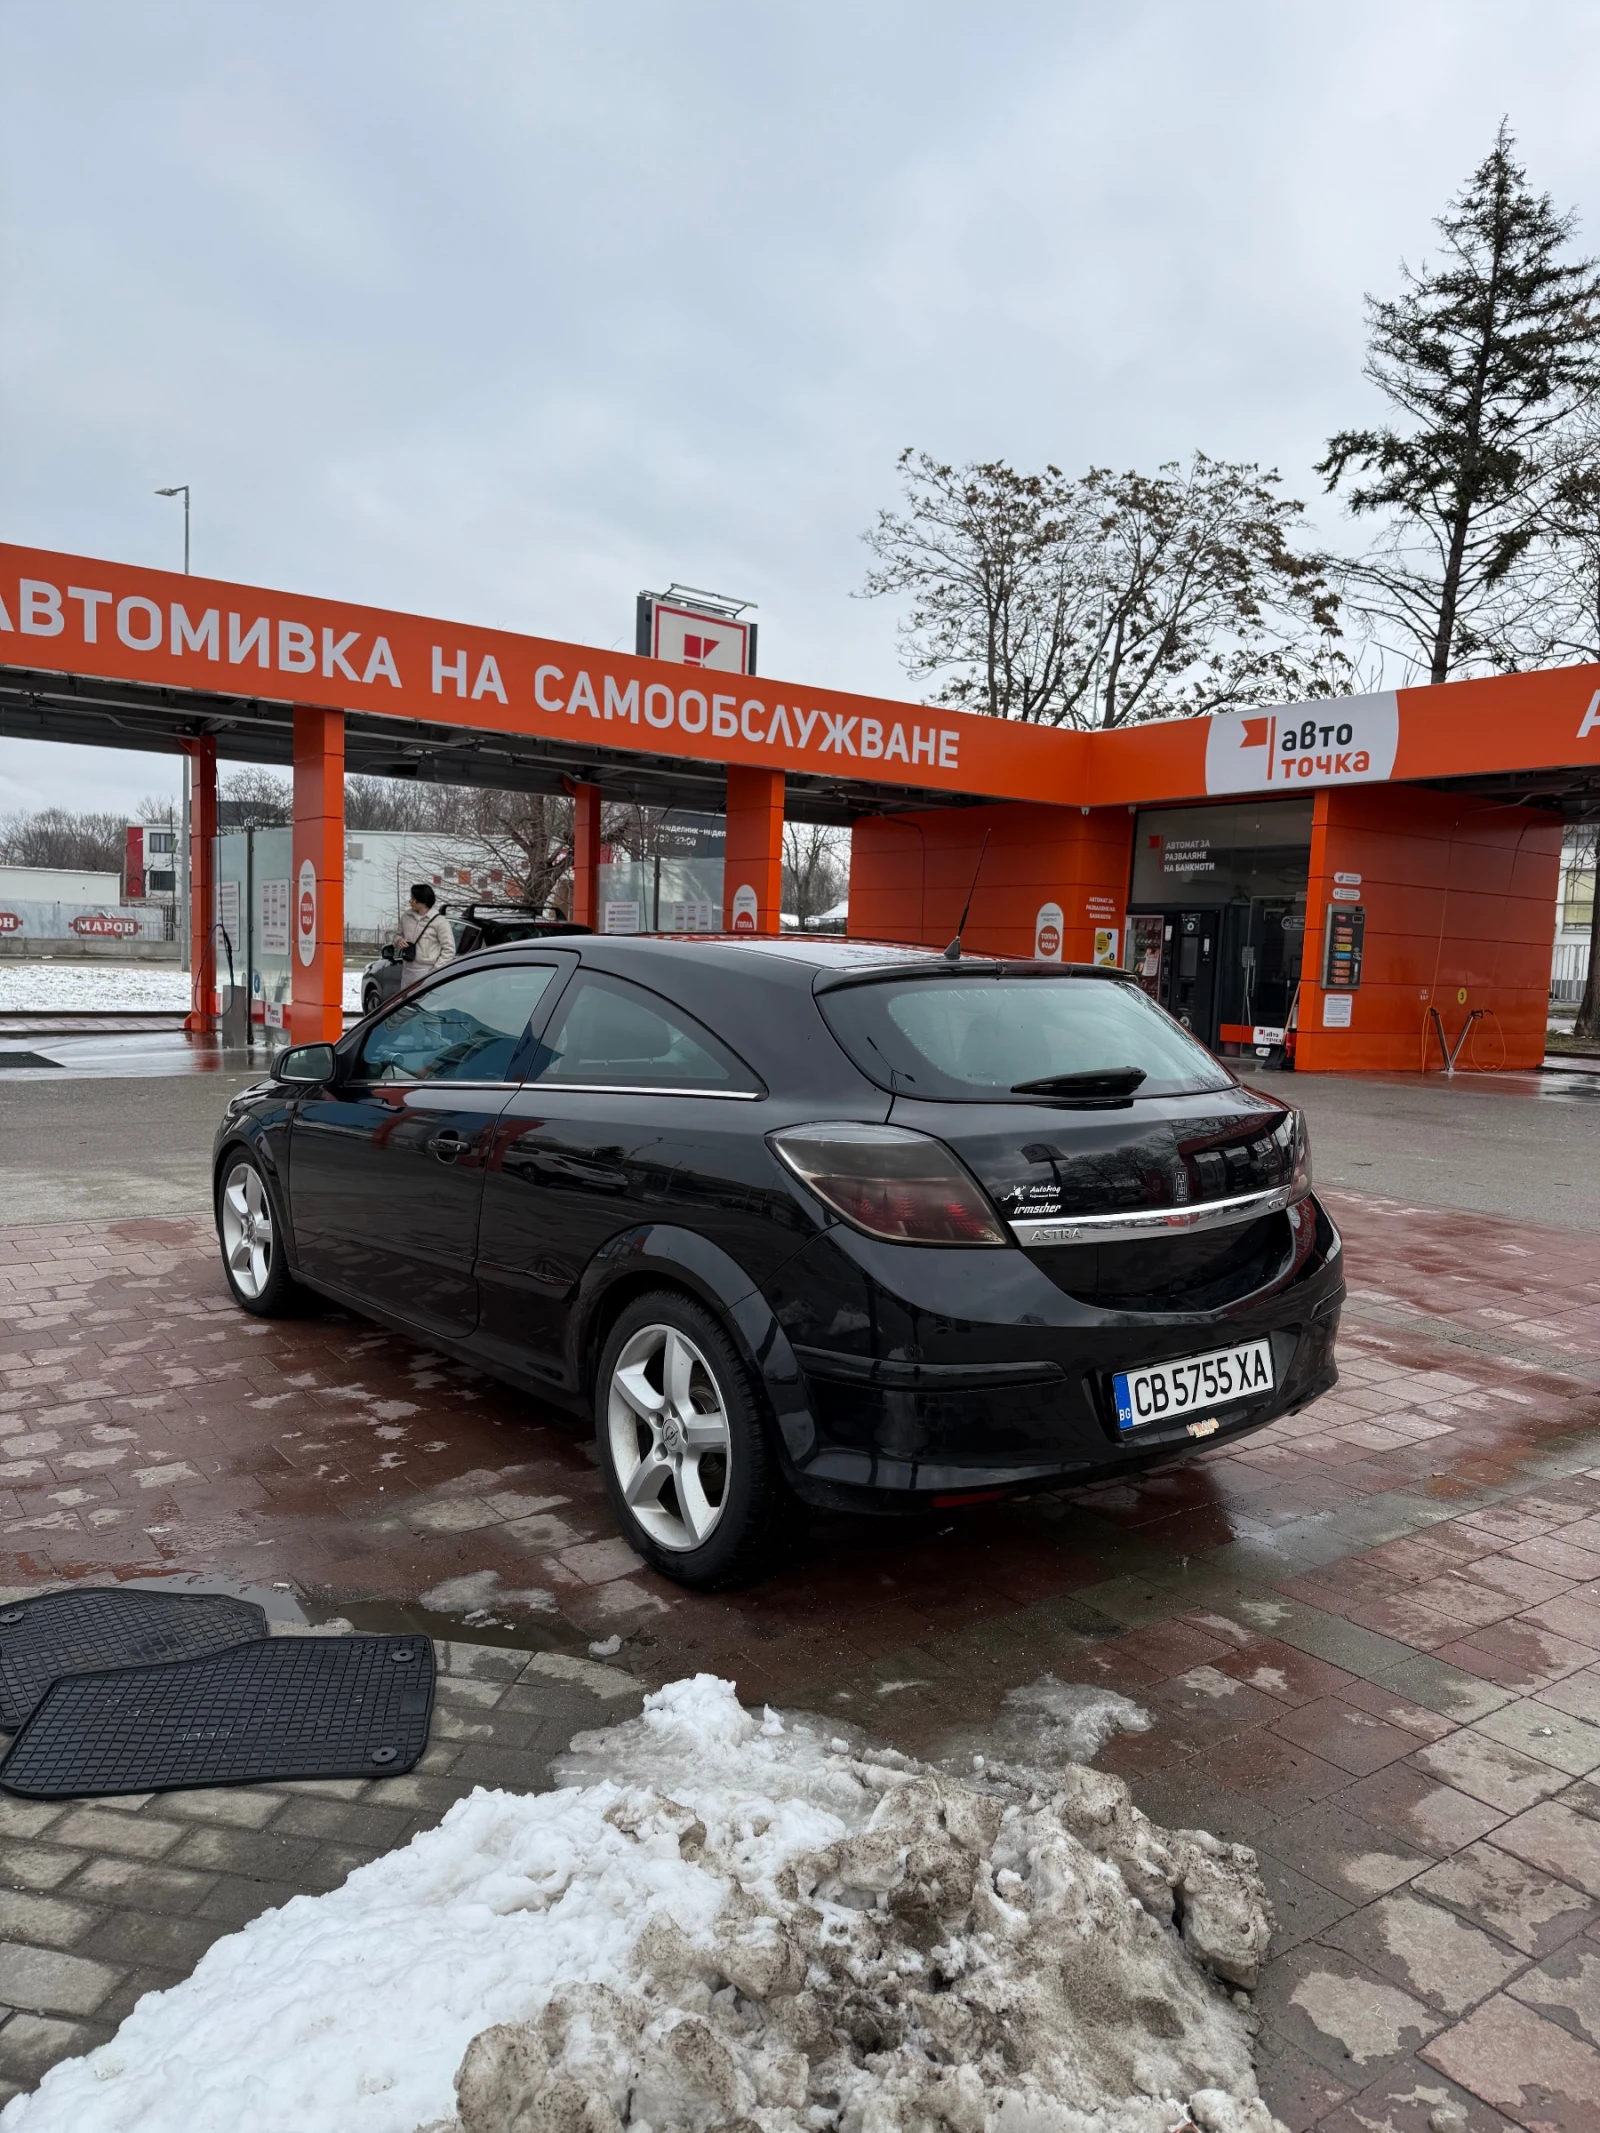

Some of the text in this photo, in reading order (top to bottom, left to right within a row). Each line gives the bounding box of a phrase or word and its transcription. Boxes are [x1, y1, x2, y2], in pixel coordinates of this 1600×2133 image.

[431, 645, 509, 705] НА
[535, 664, 960, 769] САМООБСЛУЖВАНЕ
[1281, 720, 1353, 751] авто
[1281, 748, 1370, 779] точка
[1165, 839, 1210, 850] АВТОМАТ ЗА
[1164, 851, 1207, 861] РАЗВАЛЯНЕ
[1163, 862, 1215, 873] НА БАНКНОТИ
[77, 920, 135, 933] МАРОН
[737, 920, 753, 929] ТОПЛА
[1041, 932, 1058, 940] ТОПЛА
[1041, 942, 1056, 950] ВОДА
[1013, 1202, 1062, 1215] irmscher
[1031, 1228, 1083, 1242] ASTRA
[1134, 1349, 1268, 1417] CB 5755 XA
[1119, 1408, 1132, 1422] BG
